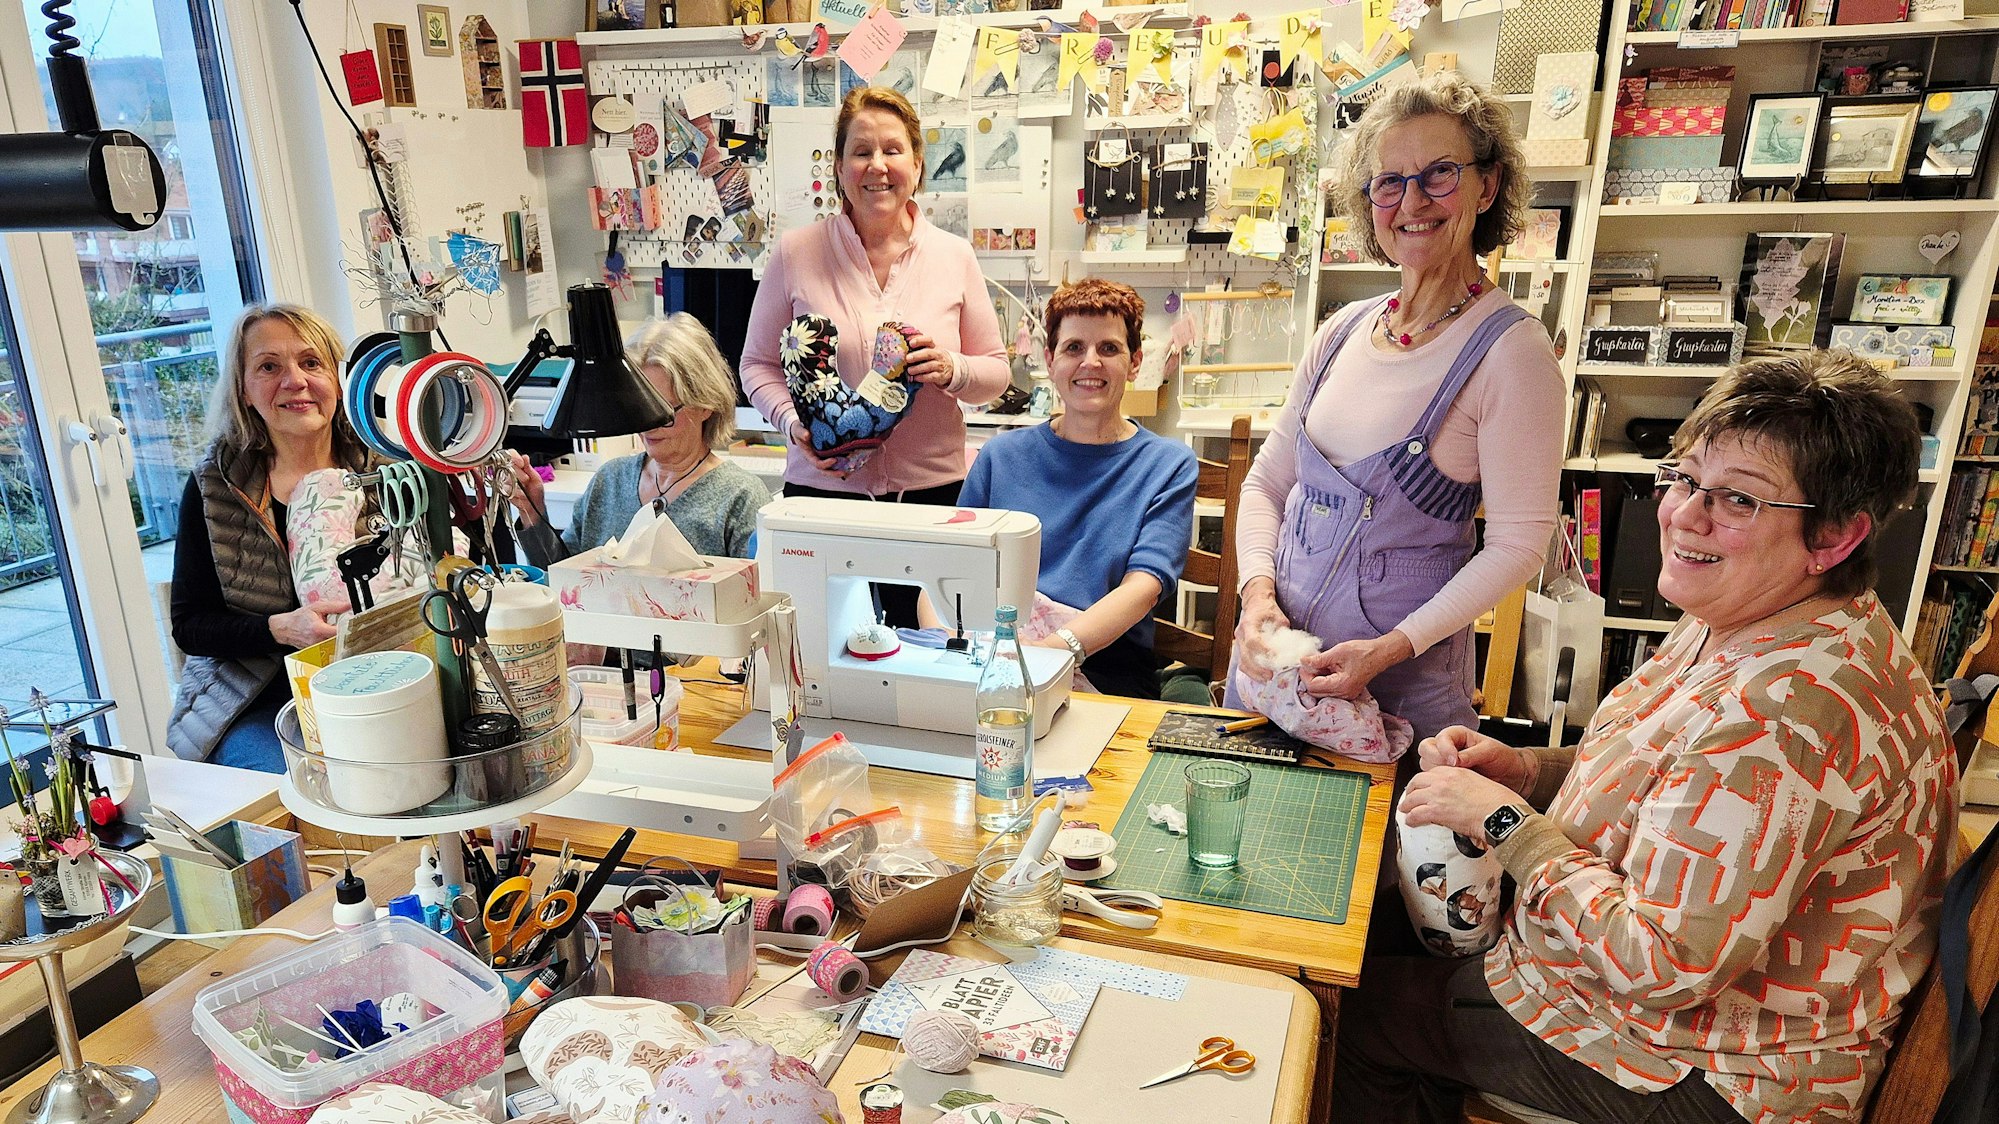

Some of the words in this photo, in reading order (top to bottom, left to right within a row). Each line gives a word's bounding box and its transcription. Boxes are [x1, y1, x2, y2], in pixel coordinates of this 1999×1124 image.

[781, 548, 815, 557] JANOME
[976, 732, 1016, 749] EROLSTEINER
[522, 743, 557, 763] ANA
[978, 769, 1007, 782] MEDIUM
[941, 977, 976, 1010] BLATT
[960, 976, 1005, 1020] APIER
[988, 985, 1015, 1017] FALTIDEEN
